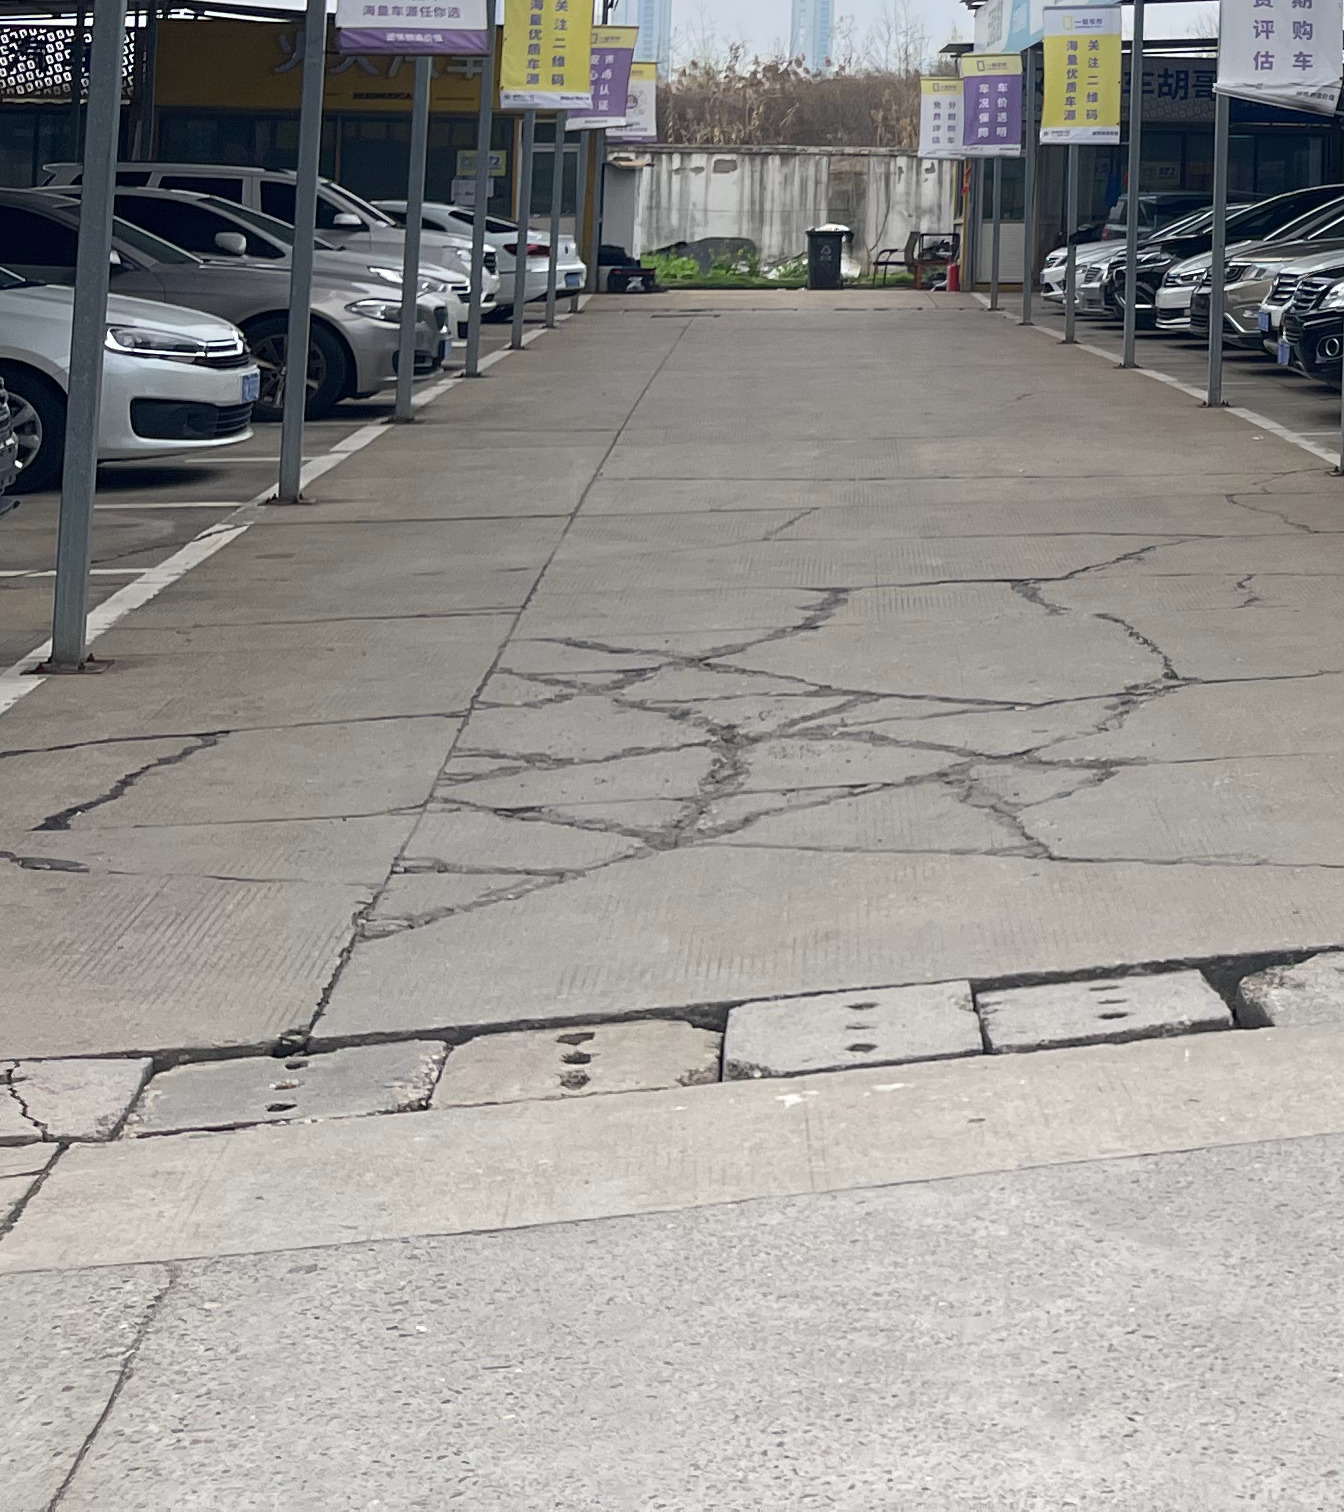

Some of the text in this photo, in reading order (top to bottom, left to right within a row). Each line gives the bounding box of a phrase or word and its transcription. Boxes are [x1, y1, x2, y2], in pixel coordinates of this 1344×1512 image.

[362, 5, 461, 19] 海量车源任你选
[552, 0, 568, 86] 关注二维码
[1086, 39, 1100, 121] 关注二维码
